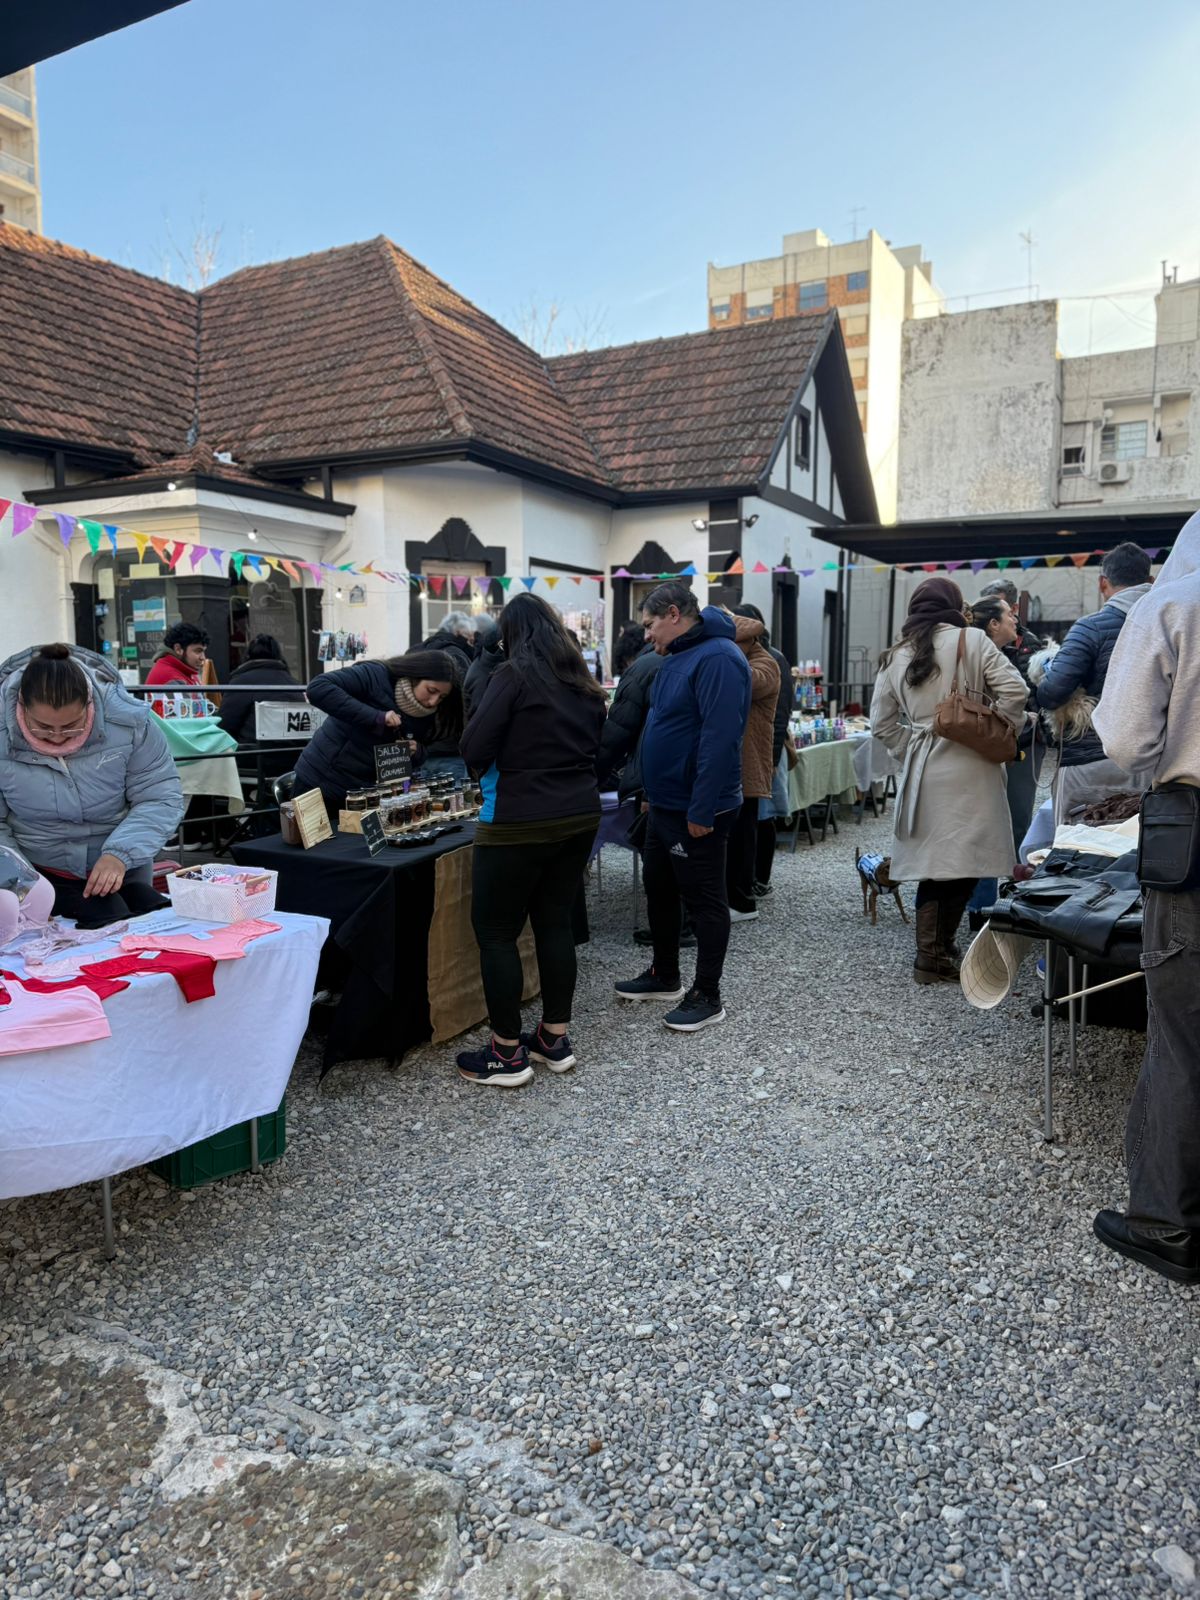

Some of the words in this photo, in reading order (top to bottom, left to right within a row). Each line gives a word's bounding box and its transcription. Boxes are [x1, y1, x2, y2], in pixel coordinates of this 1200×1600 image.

[287, 711, 311, 722] MA
[287, 721, 311, 732] NE
[377, 745, 401, 757] SALES
[487, 1061, 505, 1070] FILA
